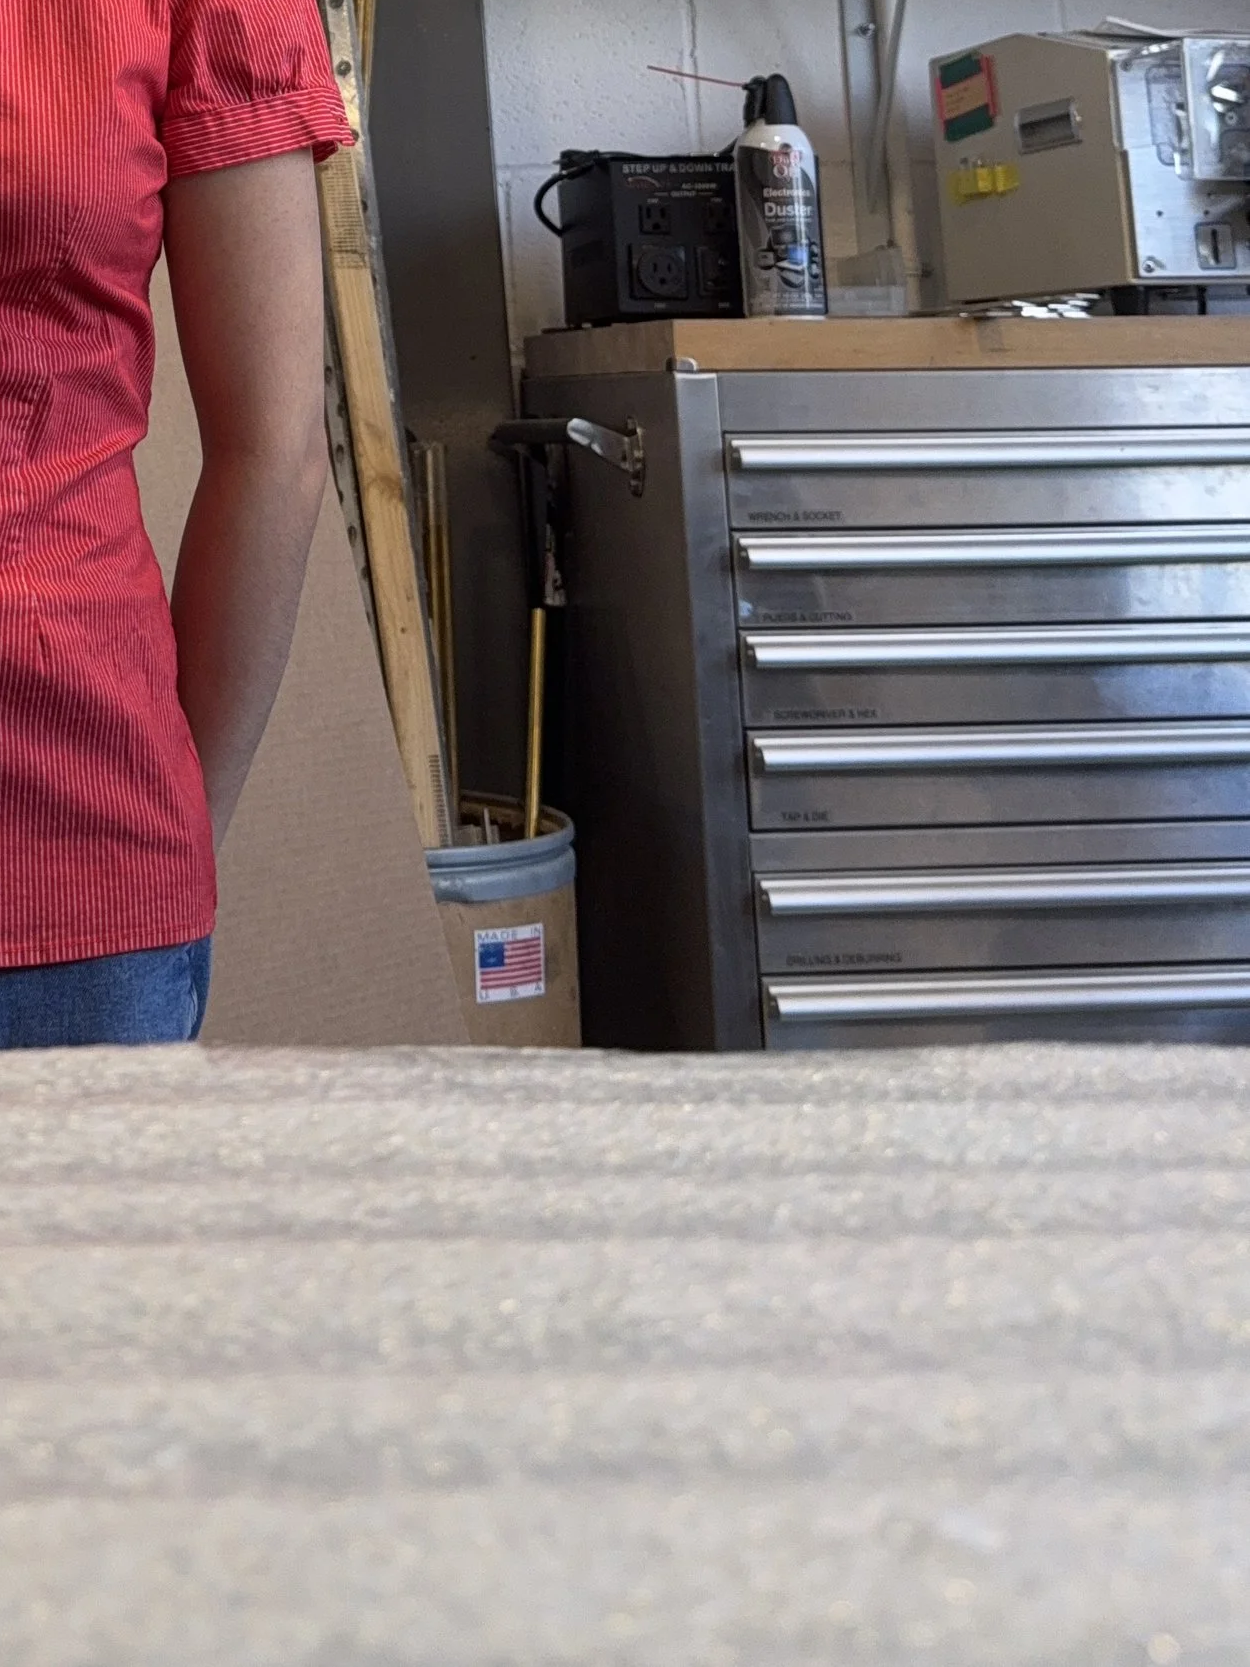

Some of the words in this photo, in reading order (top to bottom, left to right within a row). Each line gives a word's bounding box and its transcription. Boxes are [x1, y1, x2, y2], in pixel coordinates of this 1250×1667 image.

[622, 163, 650, 174] STEP
[652, 163, 667, 173] UP
[669, 163, 677, 173] &
[678, 162, 712, 173] DOWN
[764, 202, 812, 218] Duster
[802, 510, 843, 521] SOCKET
[477, 928, 517, 942] MADE
[530, 925, 541, 936] IN
